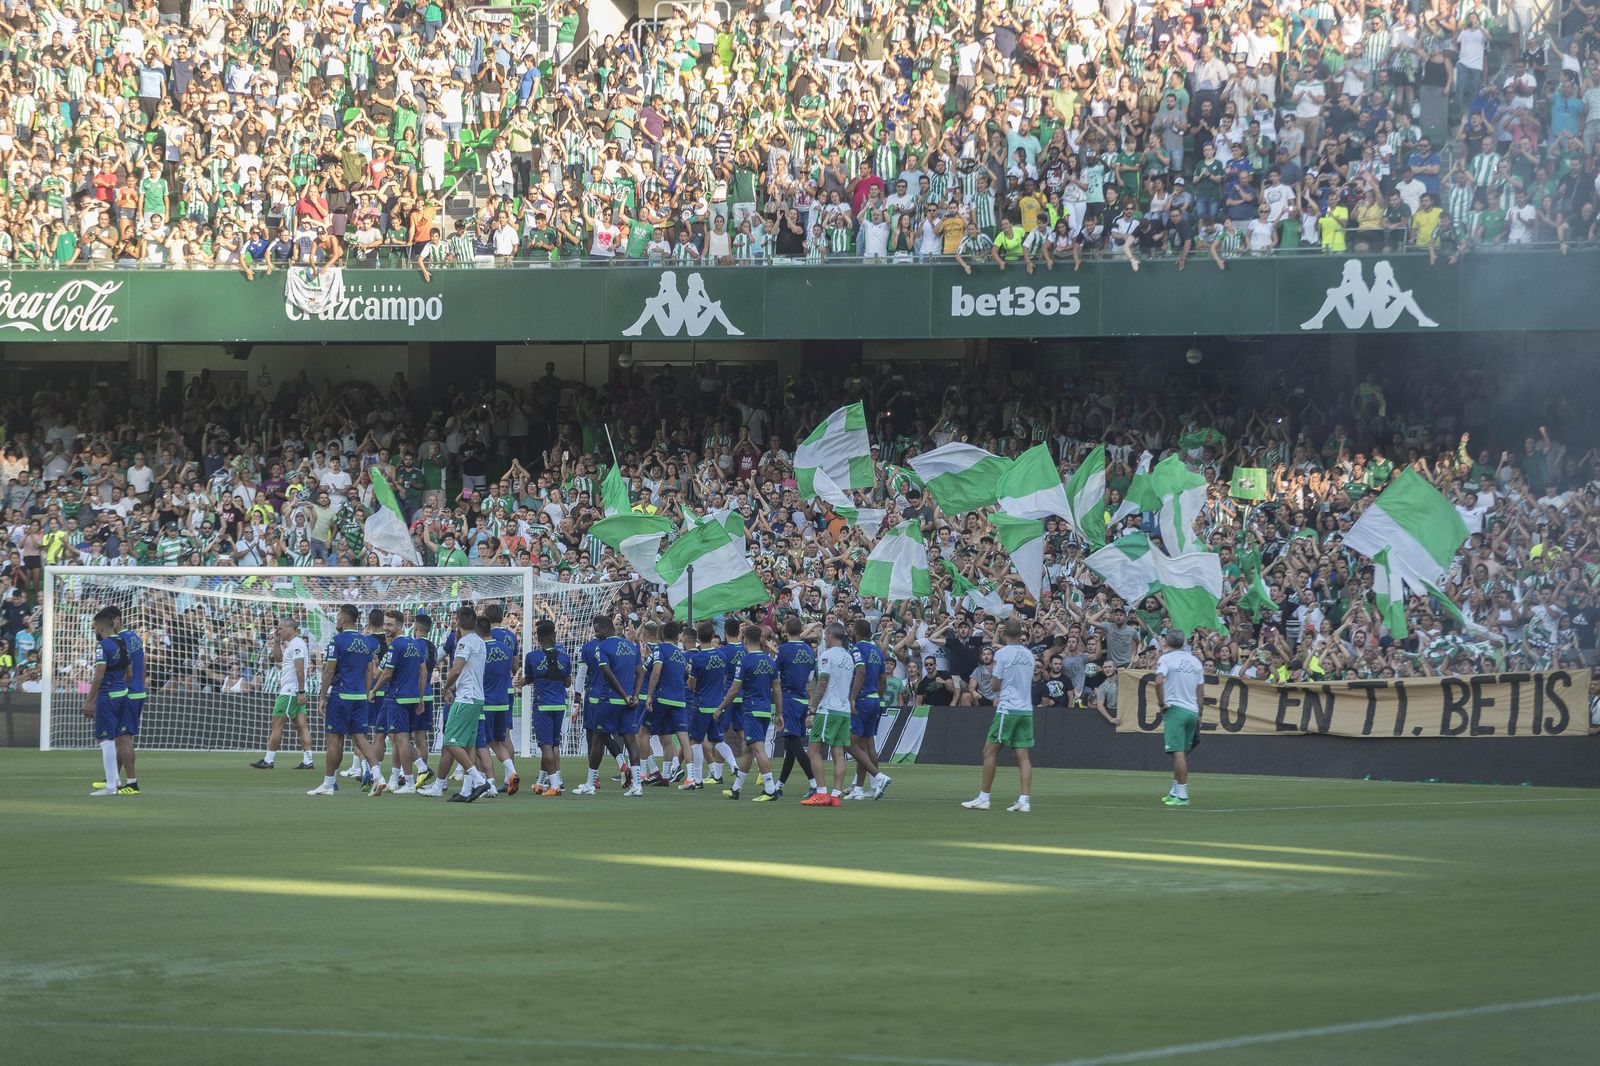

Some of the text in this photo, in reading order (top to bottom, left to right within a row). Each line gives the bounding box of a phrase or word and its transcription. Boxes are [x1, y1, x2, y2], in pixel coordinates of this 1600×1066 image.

[286, 295, 443, 326] Cuzcampo
[951, 285, 1081, 317] bet365
[1137, 670, 1572, 736] CEO EN TI. BETIS
